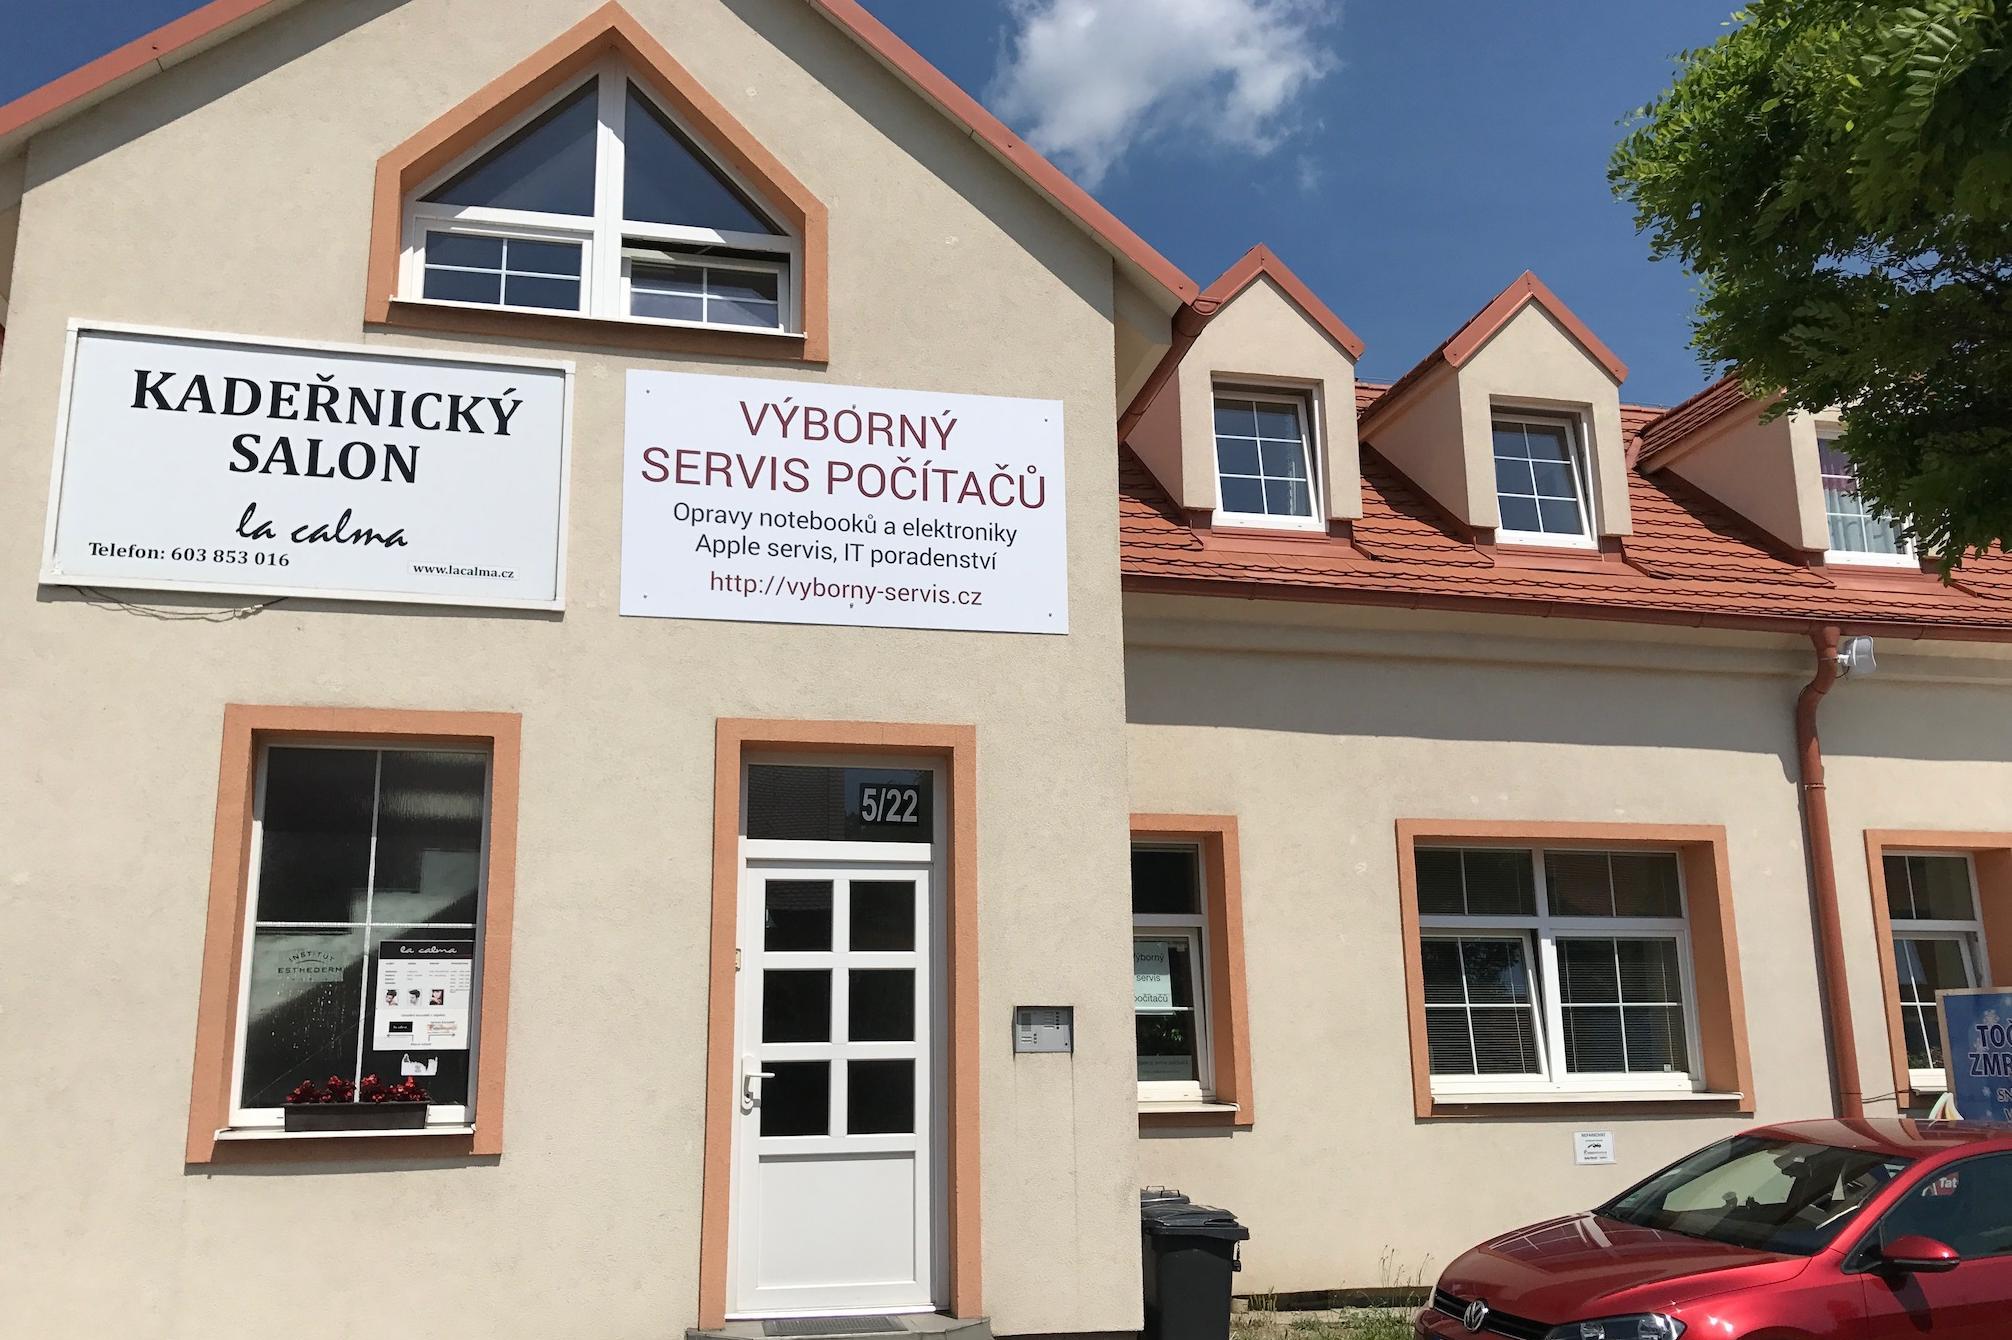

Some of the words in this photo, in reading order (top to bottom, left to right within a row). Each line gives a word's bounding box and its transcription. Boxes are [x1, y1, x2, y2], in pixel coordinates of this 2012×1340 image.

[130, 369, 523, 436] KADEŘNICKÝ
[739, 397, 958, 451] VÝBORNÝ
[229, 433, 420, 484] SALON
[641, 447, 810, 493] SERVIS
[827, 457, 1046, 510] POČÍTAČŮ
[235, 501, 275, 541] la
[290, 508, 408, 549] calma
[673, 502, 753, 530] Opravy
[759, 510, 877, 534] notebooků
[884, 519, 896, 535] a
[902, 521, 1018, 547] elektroniky
[88, 542, 165, 562] Telefon:
[170, 546, 207, 563] 603
[212, 548, 248, 565] 853
[254, 551, 290, 567] 016
[413, 562, 515, 579] www.lacalma.cz
[695, 534, 760, 560] Apple
[767, 540, 838, 564] servis,
[844, 543, 864, 563] IT
[870, 544, 998, 572] poradenství
[710, 571, 983, 607] http://vyborny-servis.cz
[861, 787, 918, 823] 5/22
[399, 945, 415, 954] la
[418, 945, 457, 954] calma
[1134, 952, 1165, 963] ýborný
[1136, 973, 1161, 982] servis
